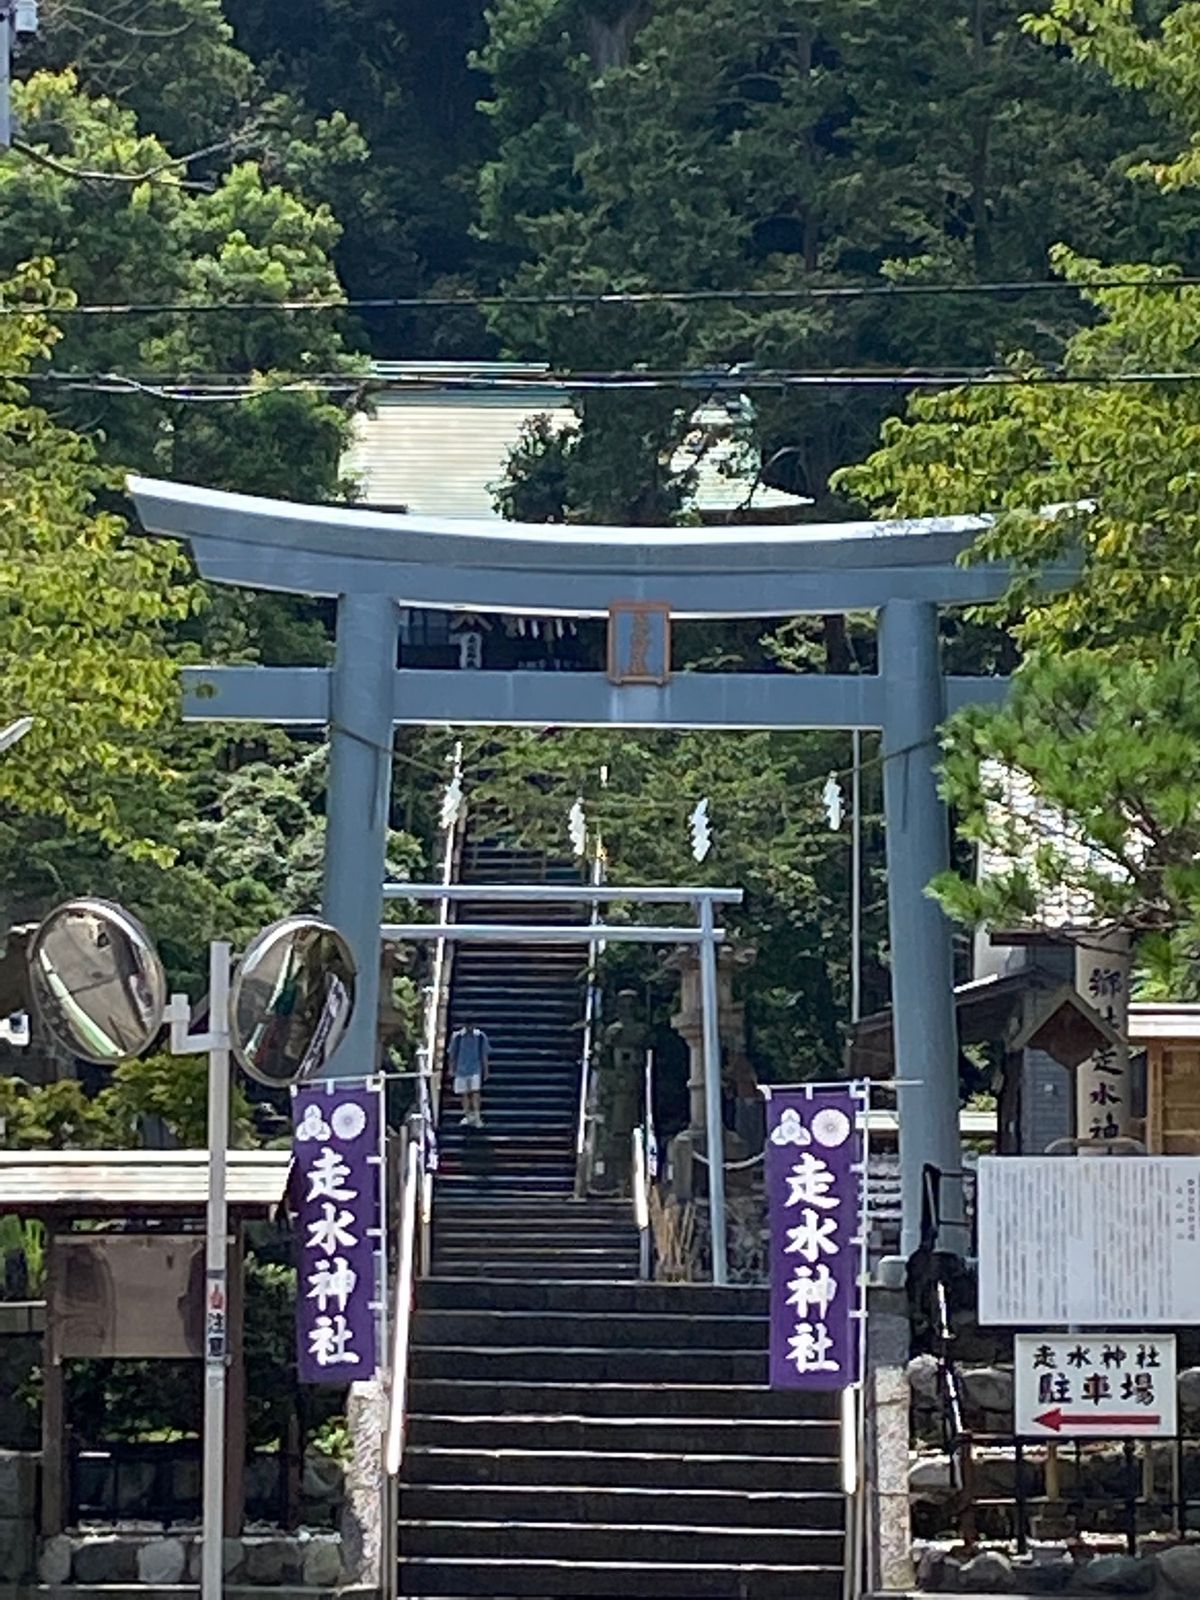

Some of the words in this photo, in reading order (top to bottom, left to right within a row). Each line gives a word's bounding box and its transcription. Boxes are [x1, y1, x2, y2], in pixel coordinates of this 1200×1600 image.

[306, 1147, 360, 1366] 走水神社
[784, 1152, 840, 1374] 走水神社
[1032, 1343, 1161, 1370] 走水神社
[1038, 1372, 1155, 1406] 駐車場
